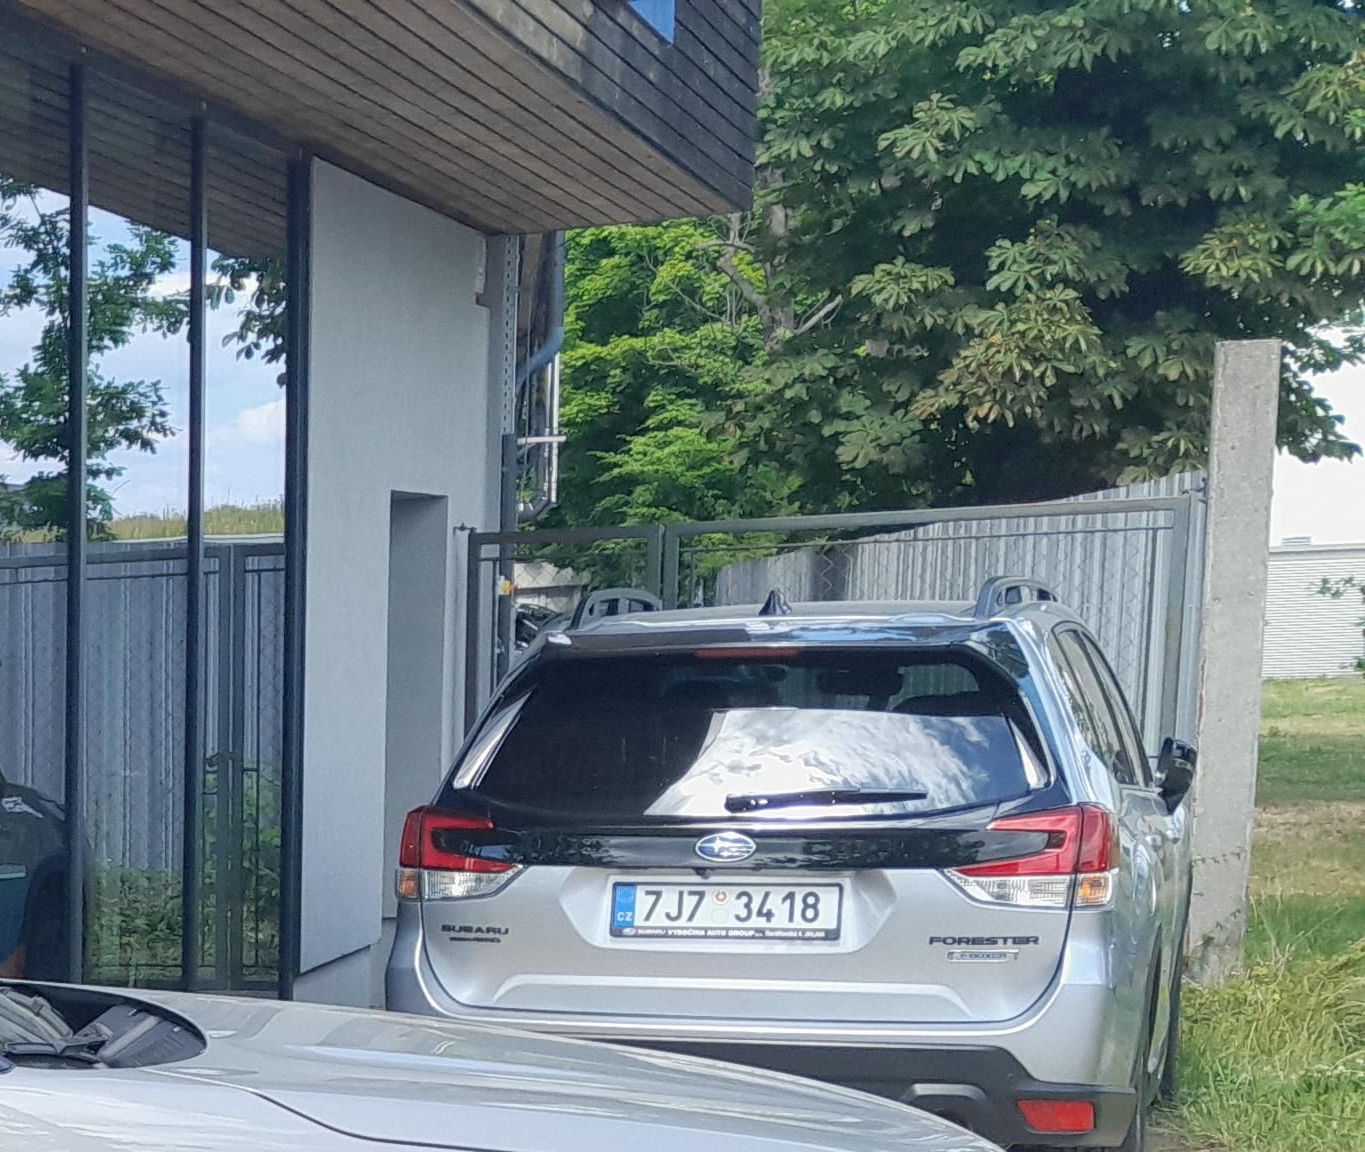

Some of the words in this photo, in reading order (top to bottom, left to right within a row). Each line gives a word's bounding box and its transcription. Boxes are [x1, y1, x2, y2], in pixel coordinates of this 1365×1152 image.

[643, 890, 706, 923] 7J7
[734, 890, 821, 924] 3418
[616, 911, 633, 922] CZ
[440, 924, 510, 935] SUBARU
[929, 935, 1040, 946] FORESTER
